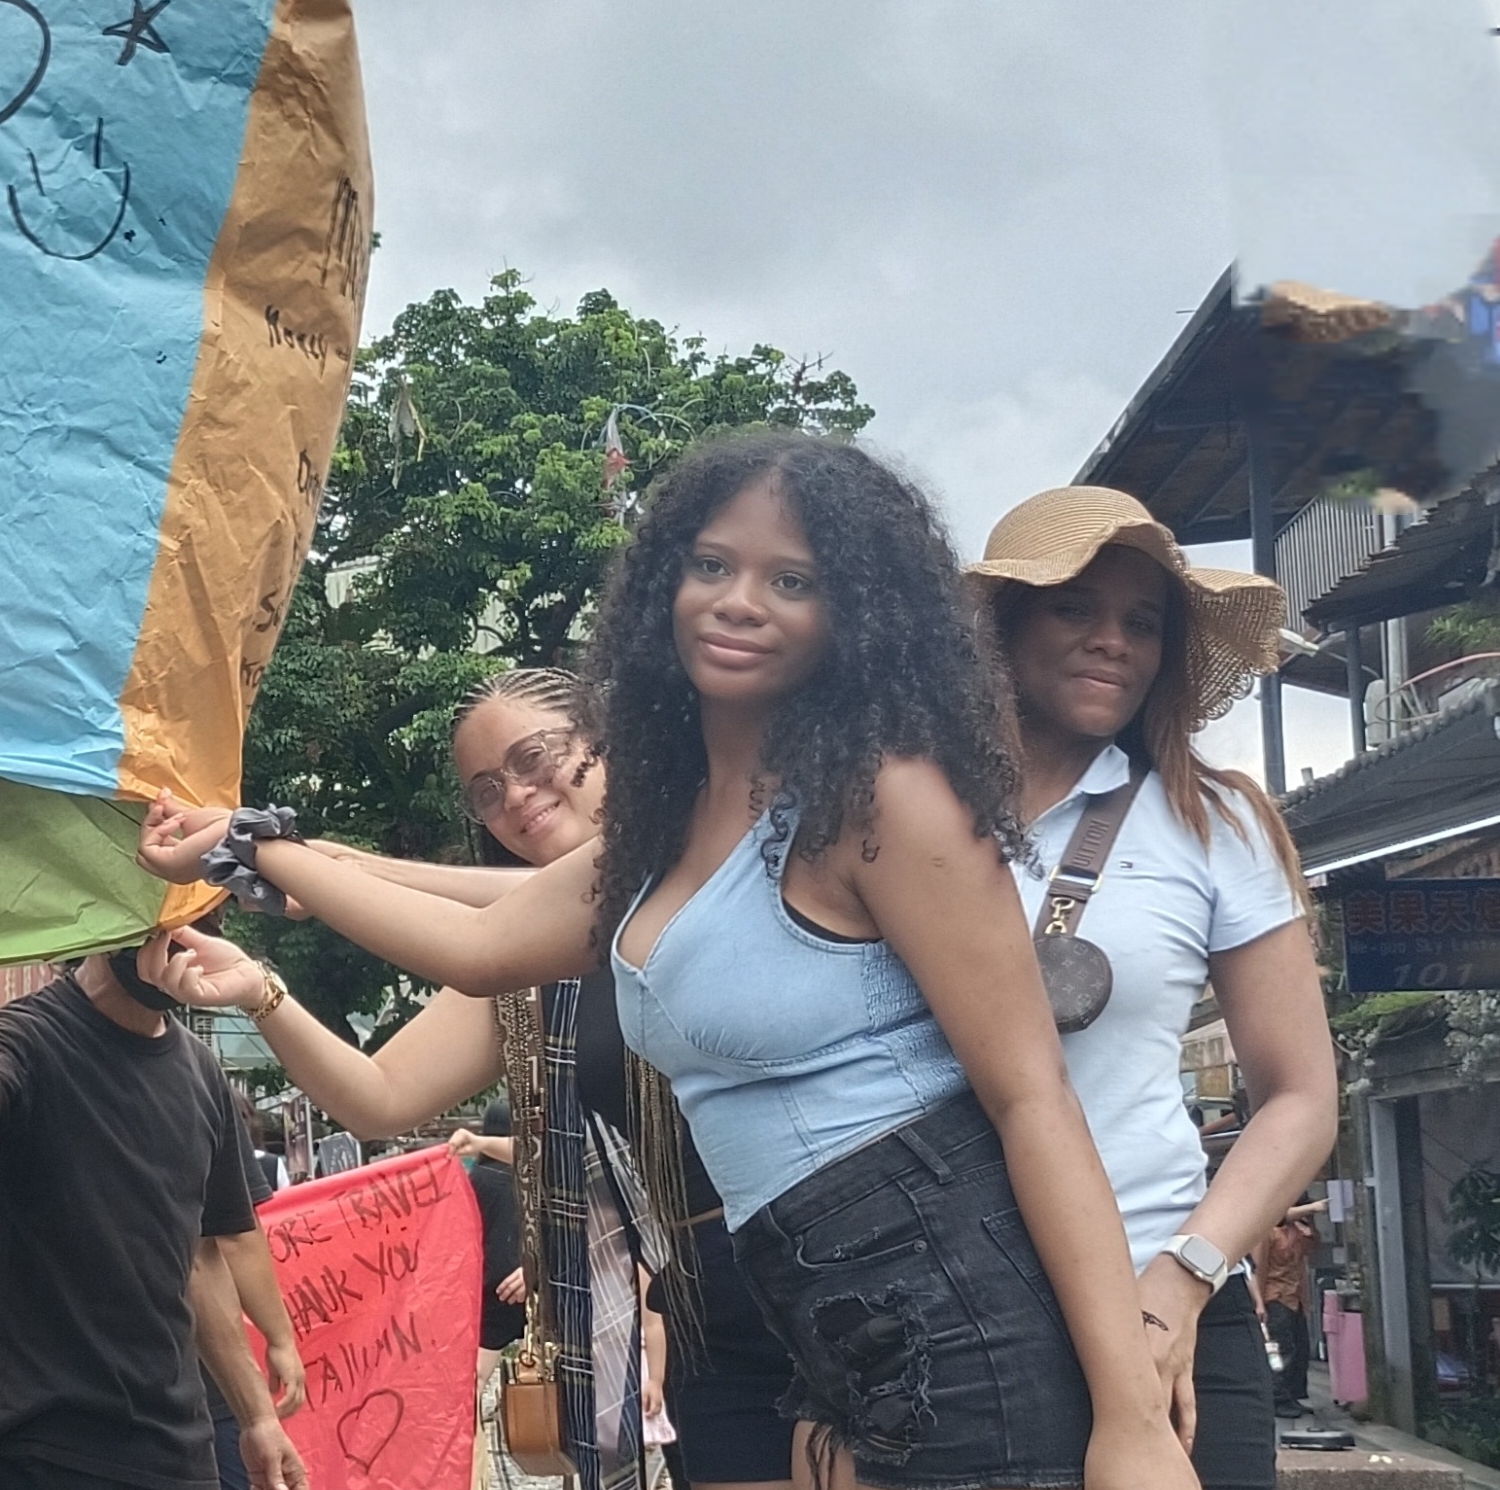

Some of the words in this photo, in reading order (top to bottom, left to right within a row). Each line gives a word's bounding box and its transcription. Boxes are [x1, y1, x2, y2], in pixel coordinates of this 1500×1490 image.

[1393, 962, 1474, 987] 101
[329, 1157, 451, 1240] TRAVEL
[353, 1238, 420, 1295] YOU
